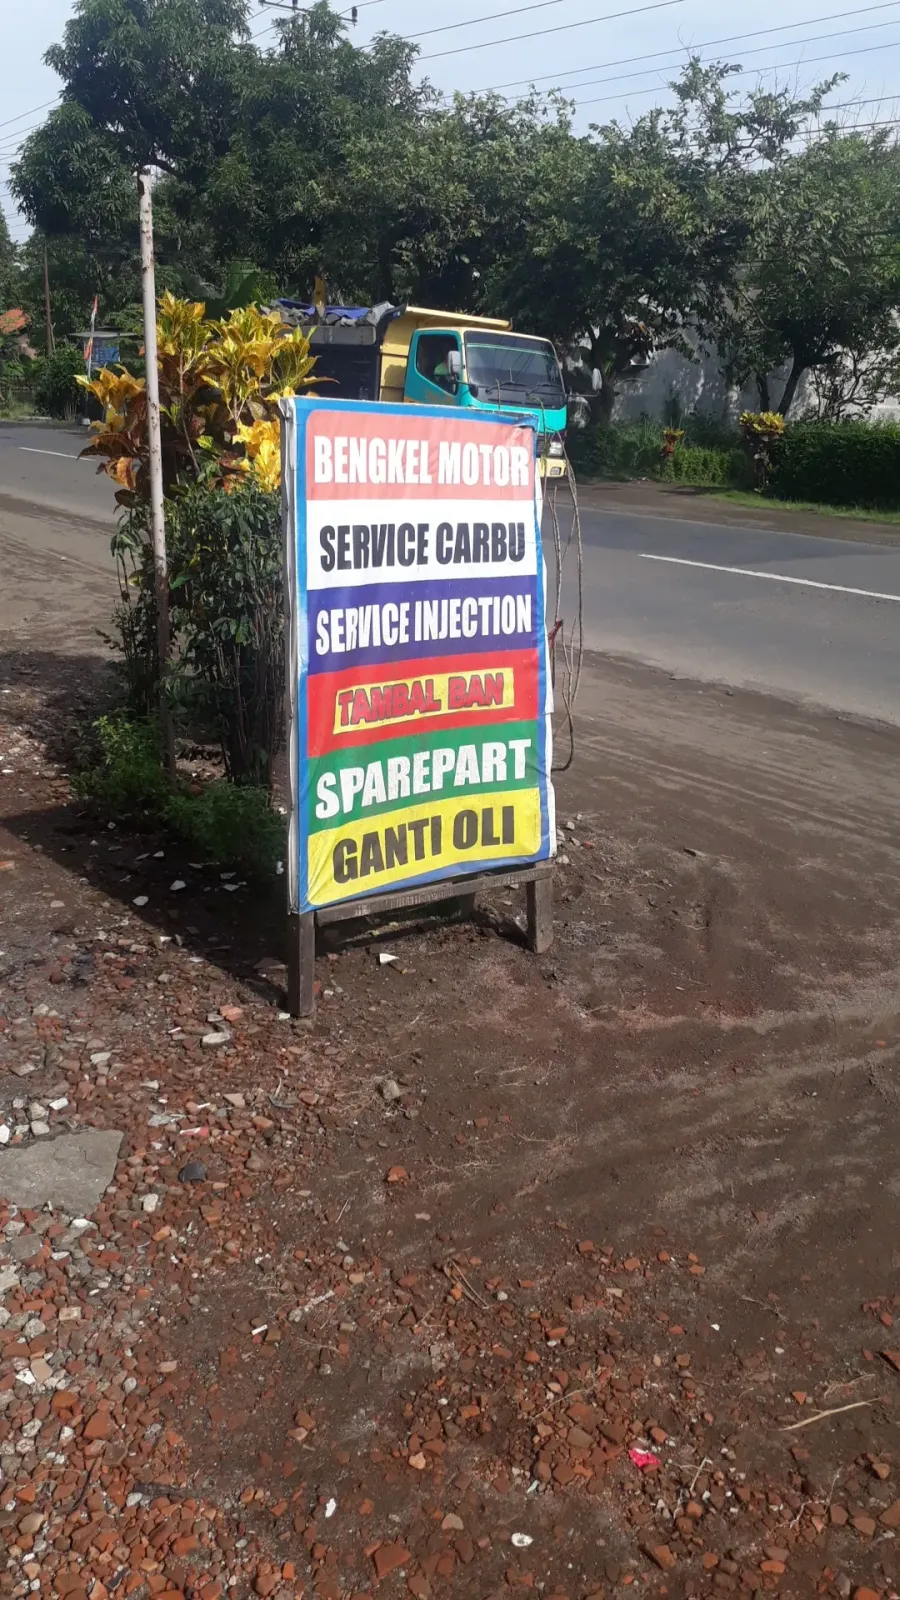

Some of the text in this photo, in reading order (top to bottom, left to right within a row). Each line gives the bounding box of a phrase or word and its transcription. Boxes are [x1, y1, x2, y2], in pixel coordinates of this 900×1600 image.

[314, 435, 530, 486] BENGKEL MOTOR
[319, 521, 525, 572] SERVICE CARBU
[315, 594, 532, 656] SERVICE INJECTION
[338, 672, 504, 727] TAMBAL BAN
[315, 738, 532, 819] SPAREPART
[332, 805, 515, 884] GANTI OLI
